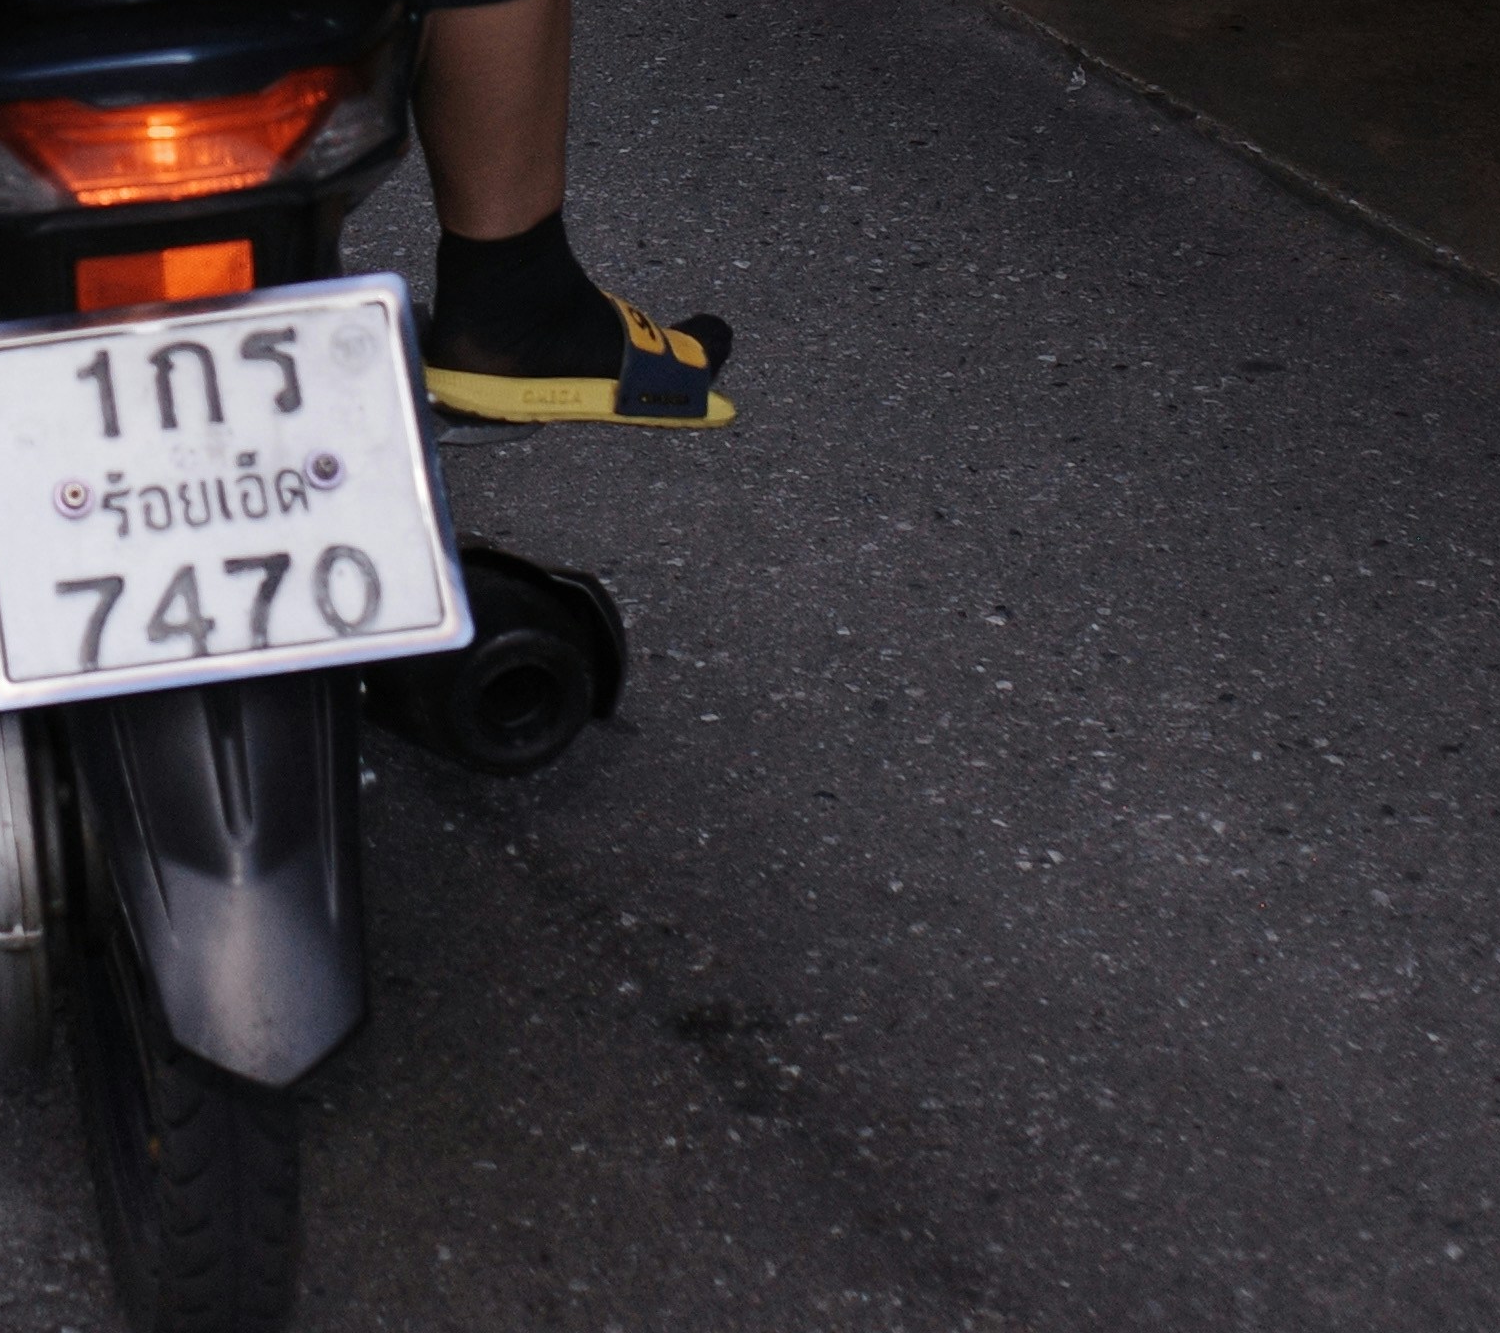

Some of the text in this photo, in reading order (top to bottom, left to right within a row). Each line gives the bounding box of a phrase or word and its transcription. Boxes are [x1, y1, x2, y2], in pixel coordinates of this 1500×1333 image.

[75, 324, 305, 438] 1กร
[102, 449, 310, 538] ร้อยเอ็ด
[54, 543, 383, 673] 7470
